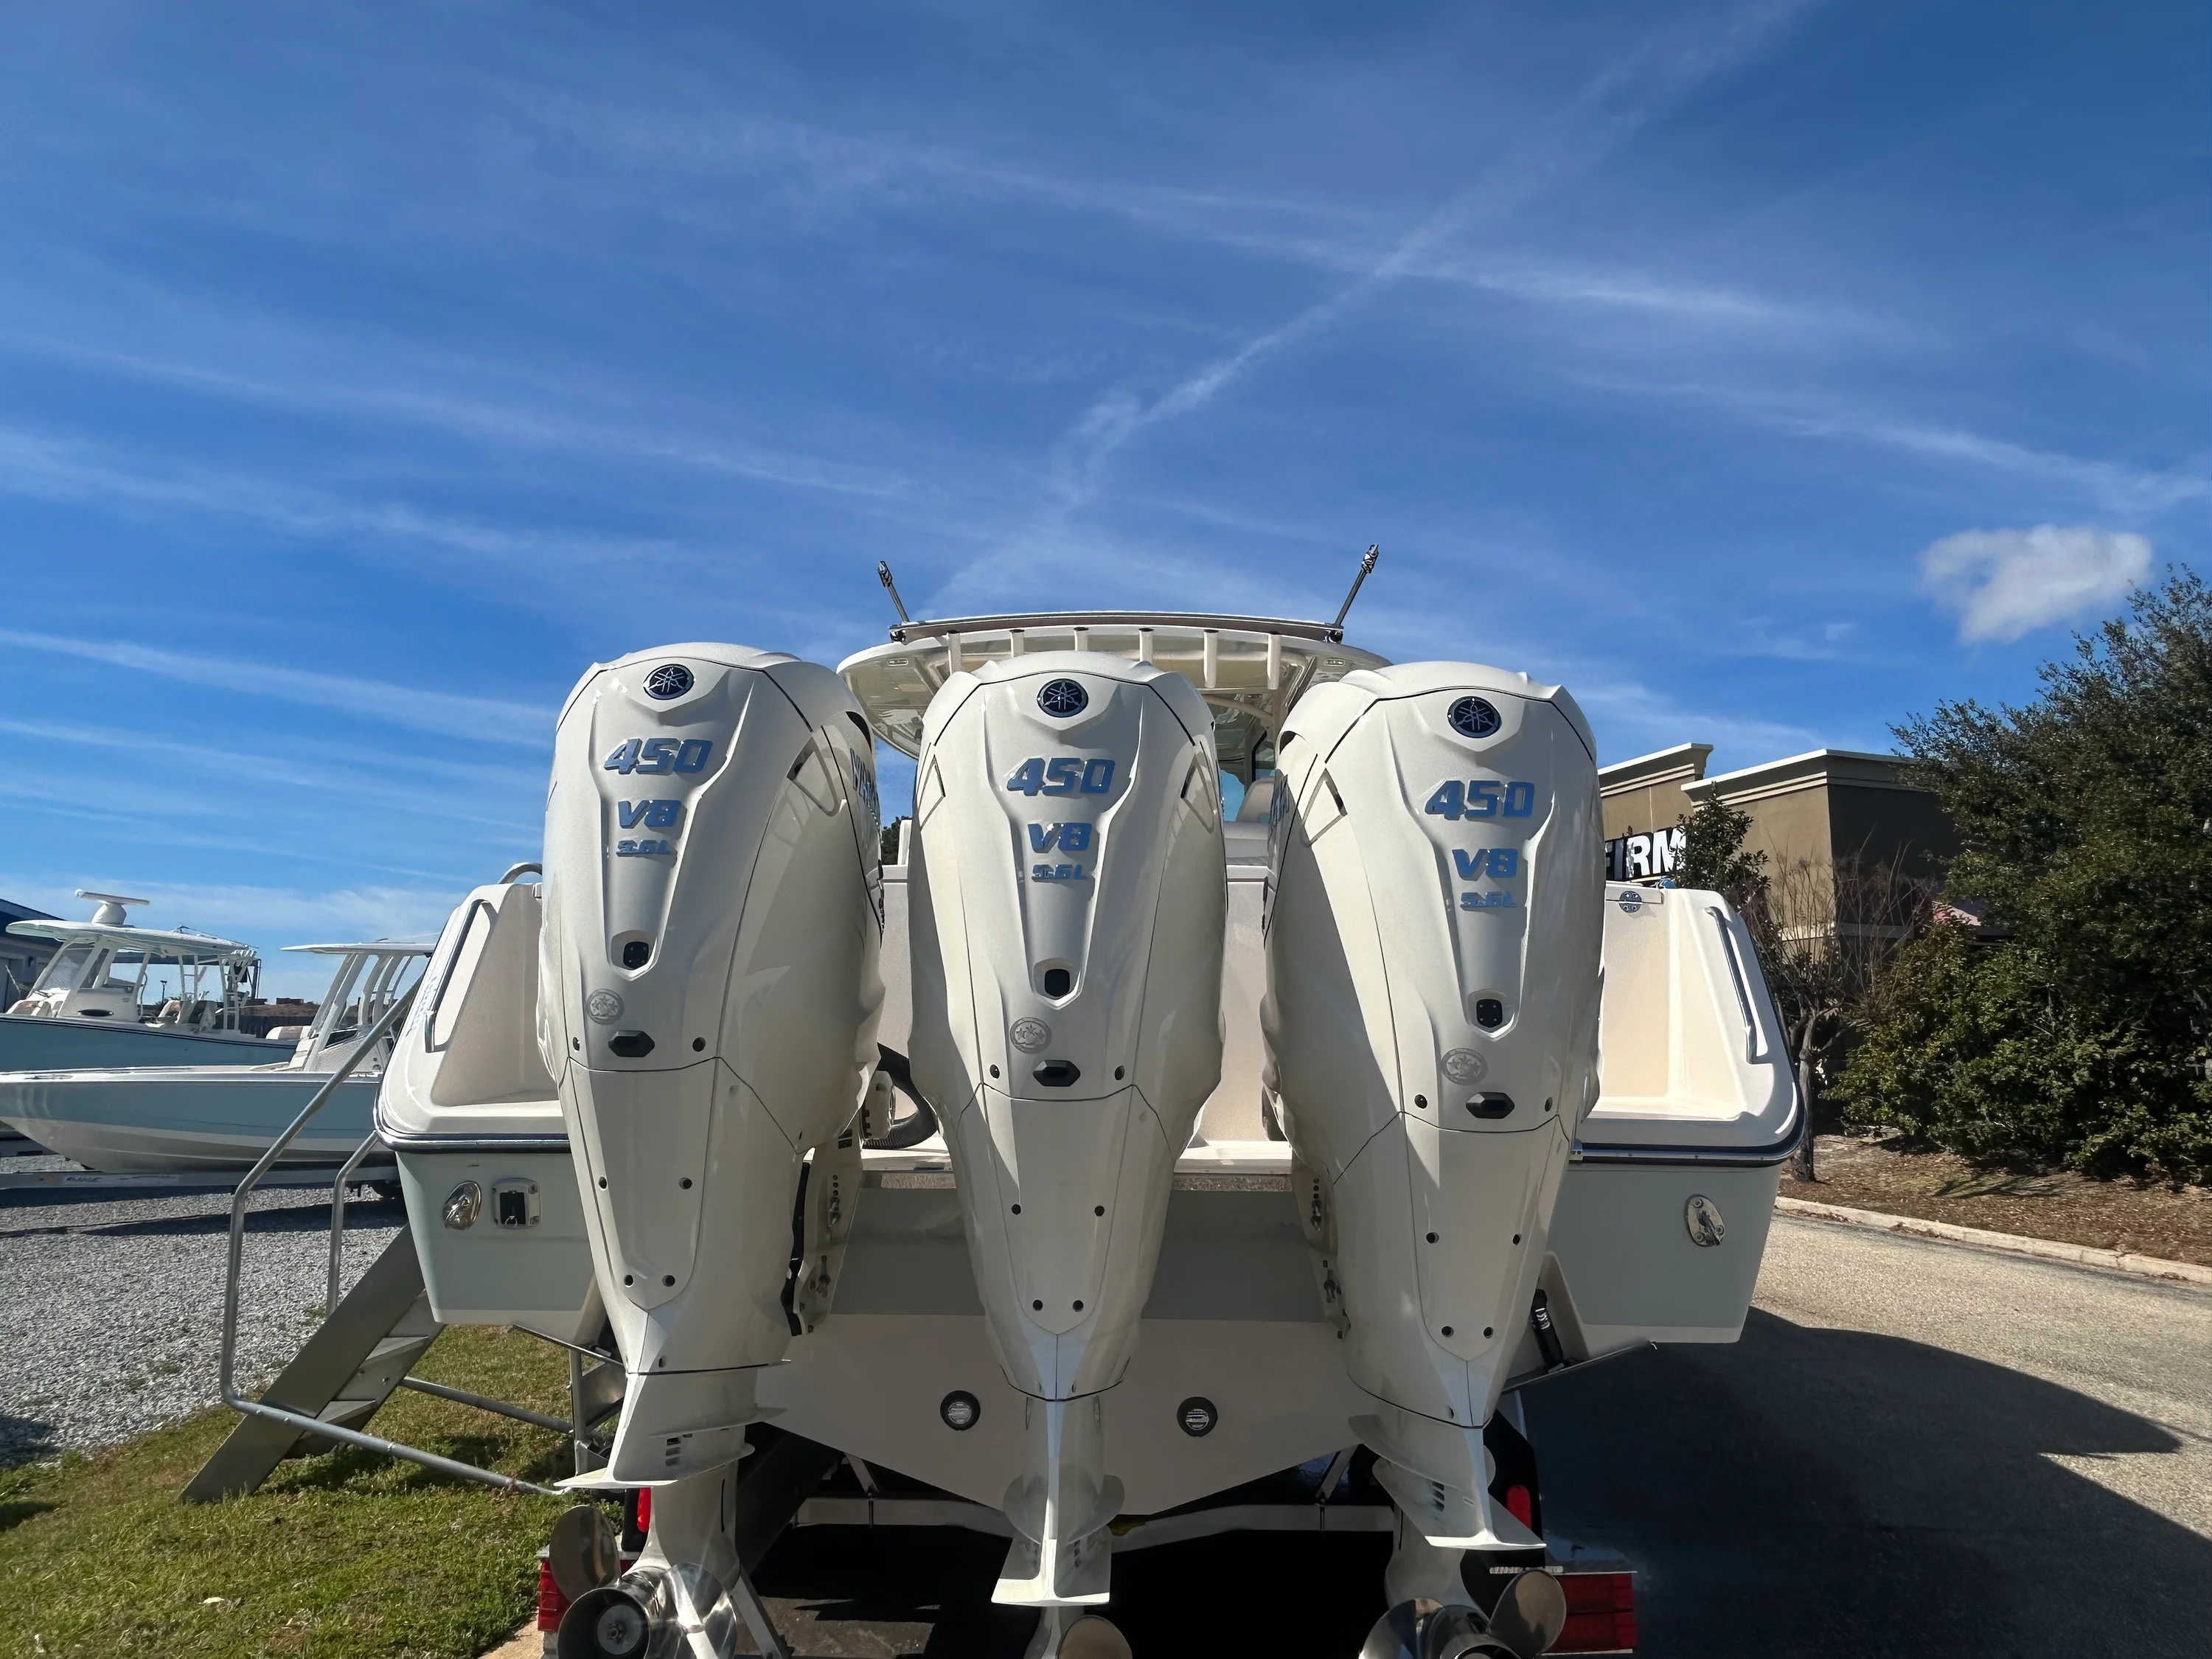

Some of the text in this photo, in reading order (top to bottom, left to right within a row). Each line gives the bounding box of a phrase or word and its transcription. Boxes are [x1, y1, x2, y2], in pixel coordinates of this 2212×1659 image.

[604, 737, 713, 776] 450
[1006, 757, 1116, 797] 450
[618, 799, 682, 829] V8
[1425, 780, 1535, 821] 450
[1028, 822, 1092, 853] V8
[1452, 848, 1518, 882] V8
